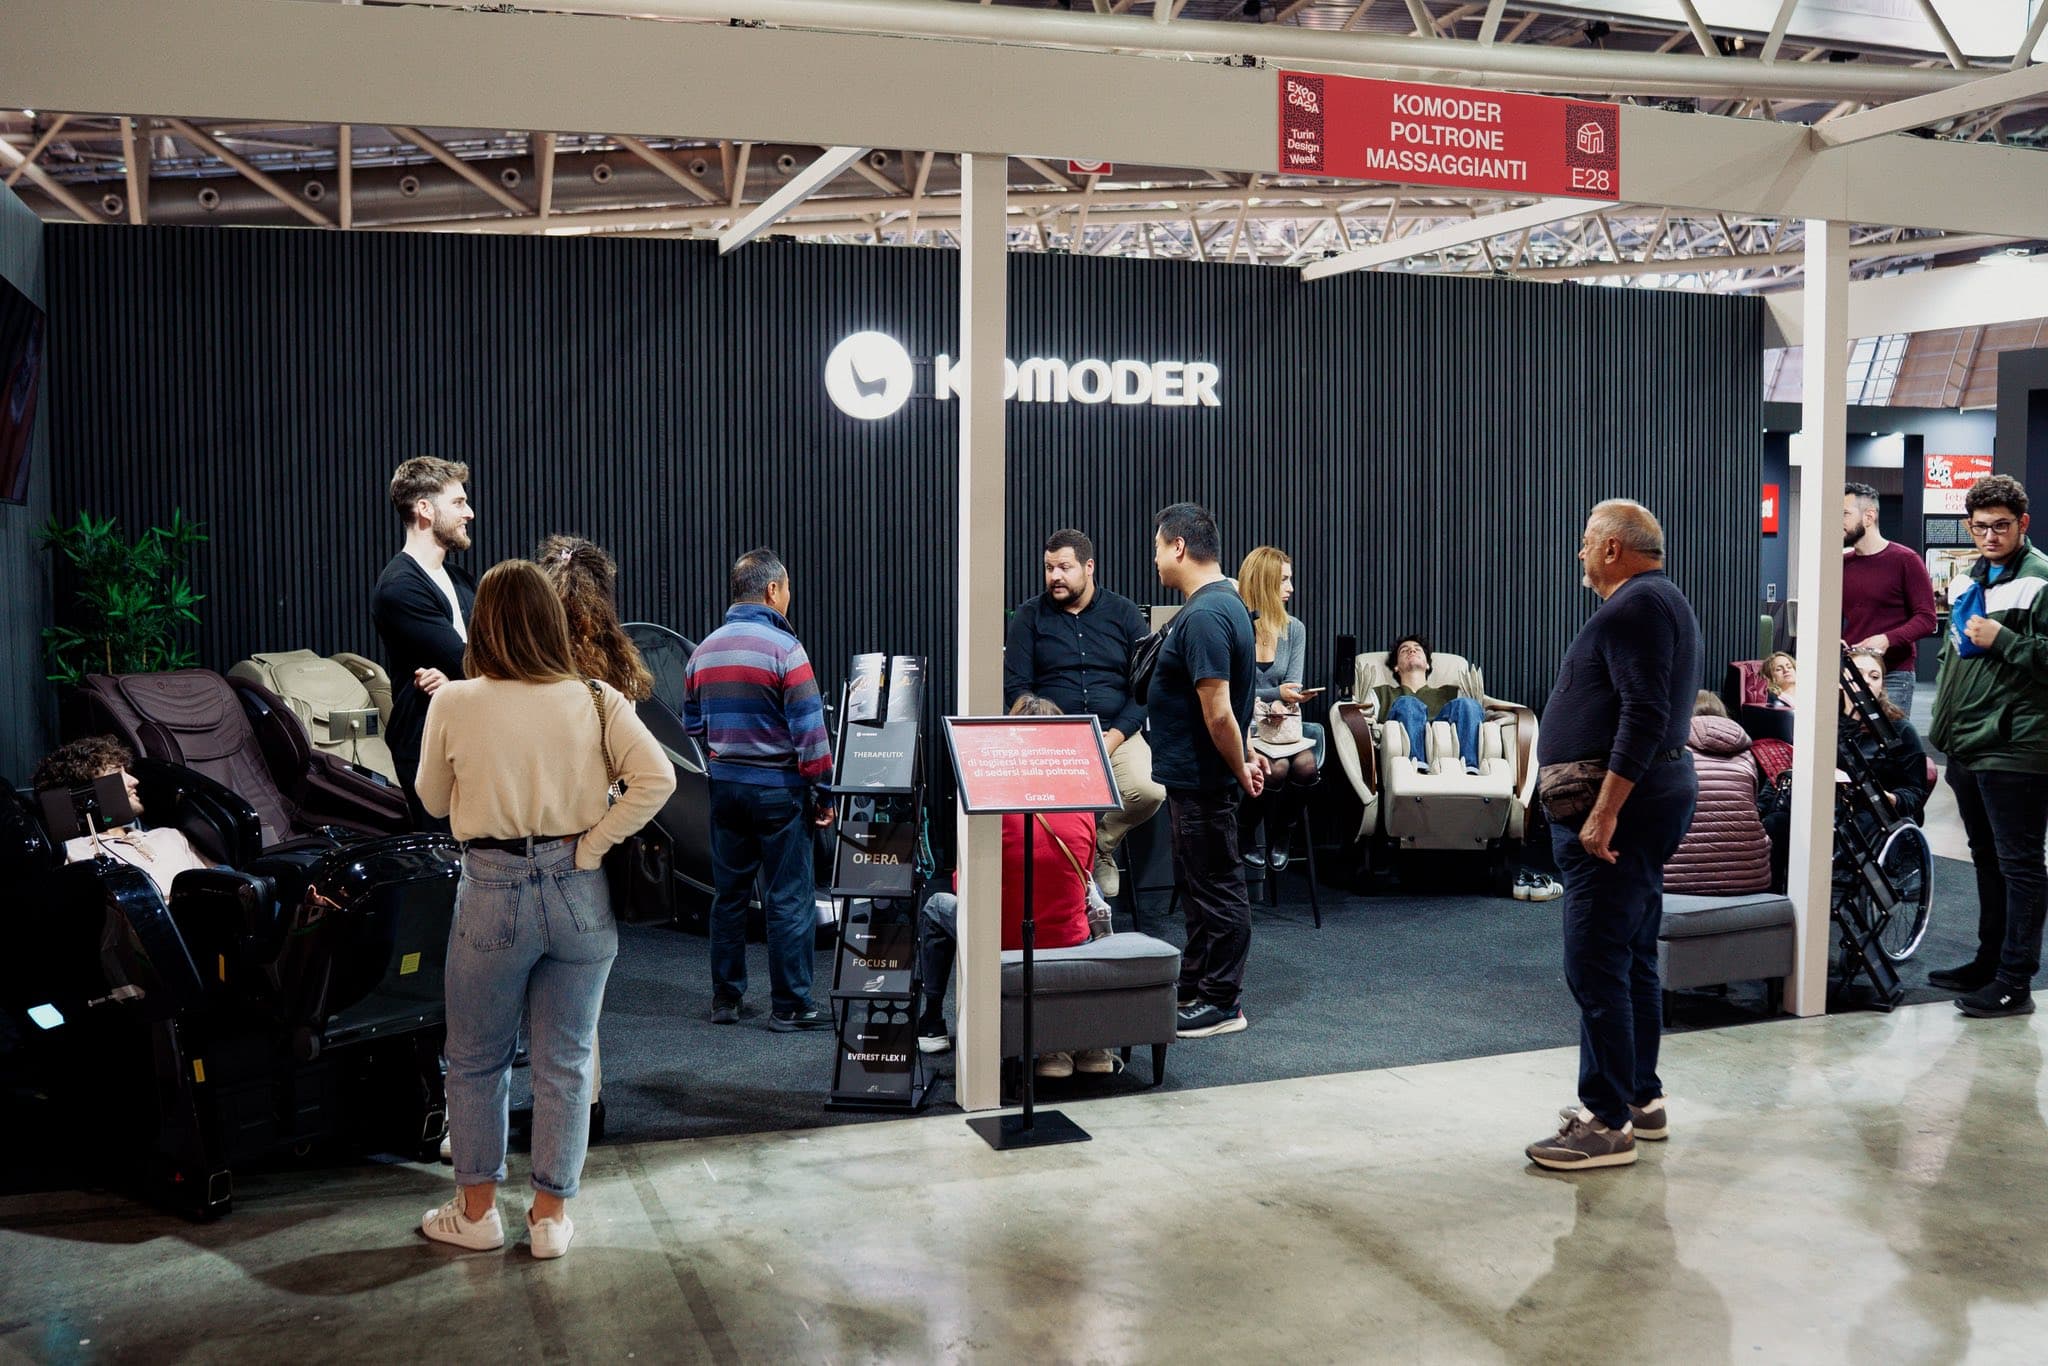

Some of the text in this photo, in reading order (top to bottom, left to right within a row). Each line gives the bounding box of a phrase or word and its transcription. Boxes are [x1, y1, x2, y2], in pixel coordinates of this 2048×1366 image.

[1287, 81, 1317, 103] EXPO
[1288, 93, 1320, 114] CASA
[1393, 94, 1501, 123] KOMODER
[1291, 129, 1315, 140] Turin
[1391, 122, 1504, 151] POLTRONE
[1287, 139, 1320, 154] Design
[1289, 154, 1317, 165] Week
[1366, 149, 1527, 181] MASSAGGIANTI
[1572, 167, 1610, 191] E28
[853, 751, 904, 759] THERAPEUTIX
[1021, 747, 1077, 758] gentilmente
[1030, 760, 1060, 768] scarpe
[1062, 758, 1090, 766] prima
[985, 767, 1019, 777] sedersi
[1020, 769, 1044, 777] sulla
[1025, 793, 1056, 802] Grazie
[852, 852, 899, 866] OPERA
[852, 958, 898, 968] FOCUS III
[847, 1053, 880, 1062] EVEREST
[880, 1054, 900, 1062] FLEX
